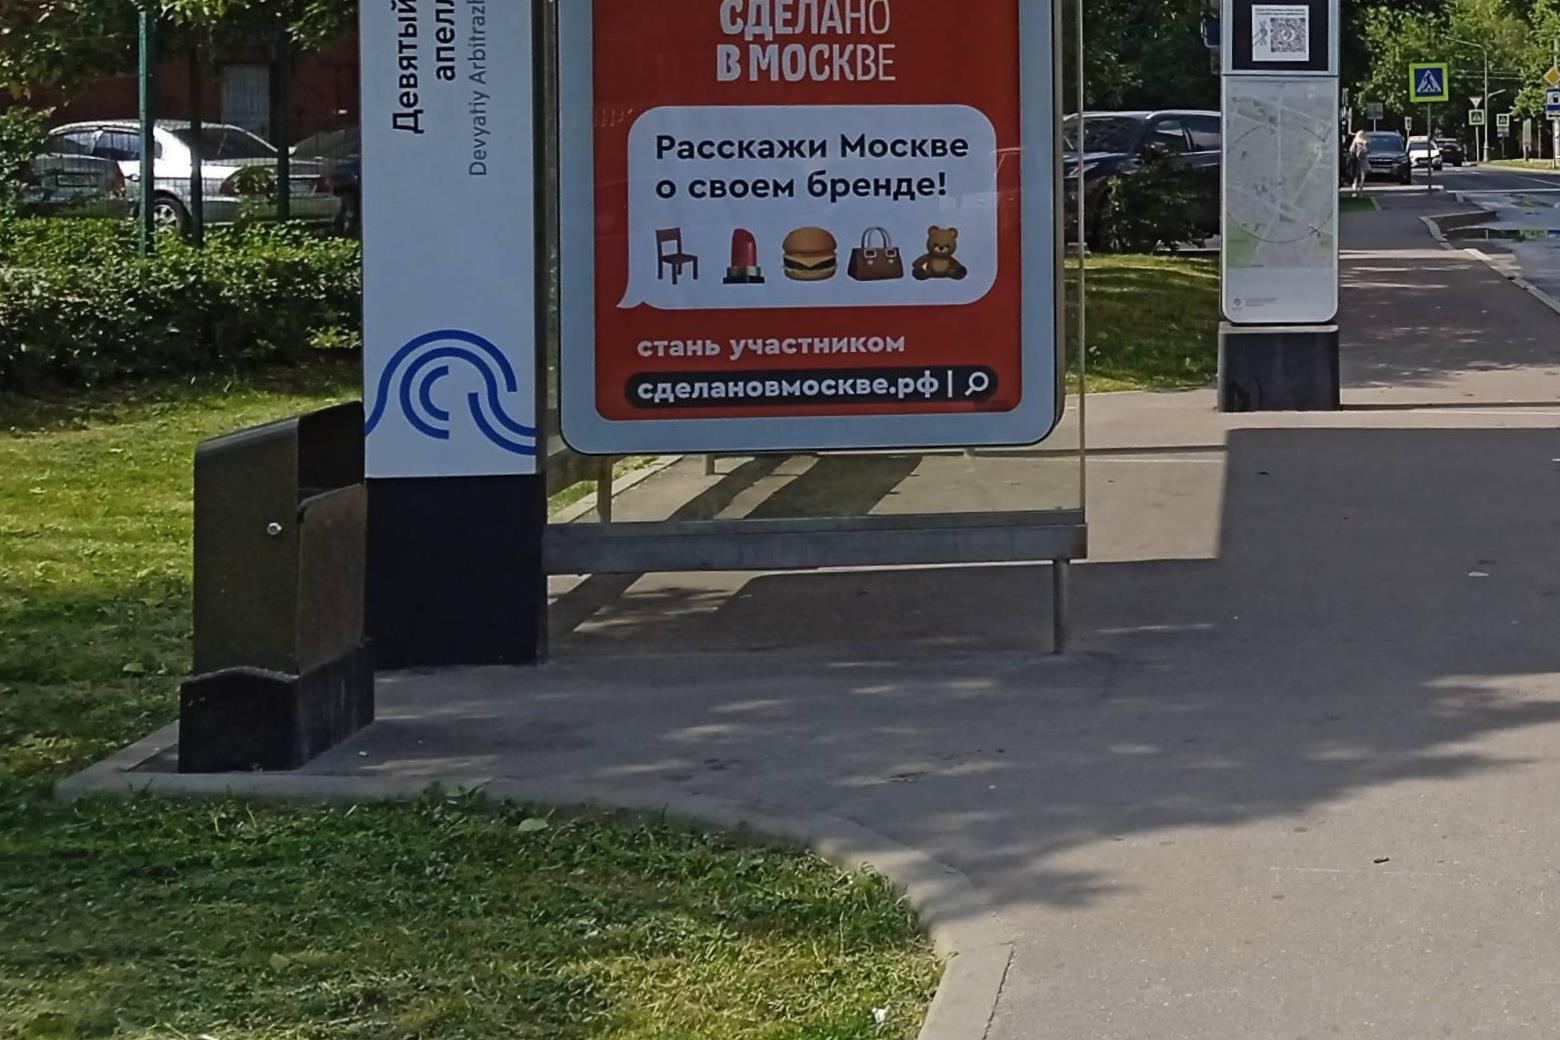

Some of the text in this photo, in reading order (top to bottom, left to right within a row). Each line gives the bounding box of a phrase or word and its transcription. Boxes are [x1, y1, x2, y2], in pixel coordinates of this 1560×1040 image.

[716, 43, 897, 82] В МОСКВЕ
[468, 90, 491, 176] Devyatiy
[655, 133, 969, 160] Расскажи Москве
[655, 170, 947, 204] о своем бренде!
[636, 335, 906, 361] стань участником
[636, 370, 940, 404] сделановмоскве.рф
